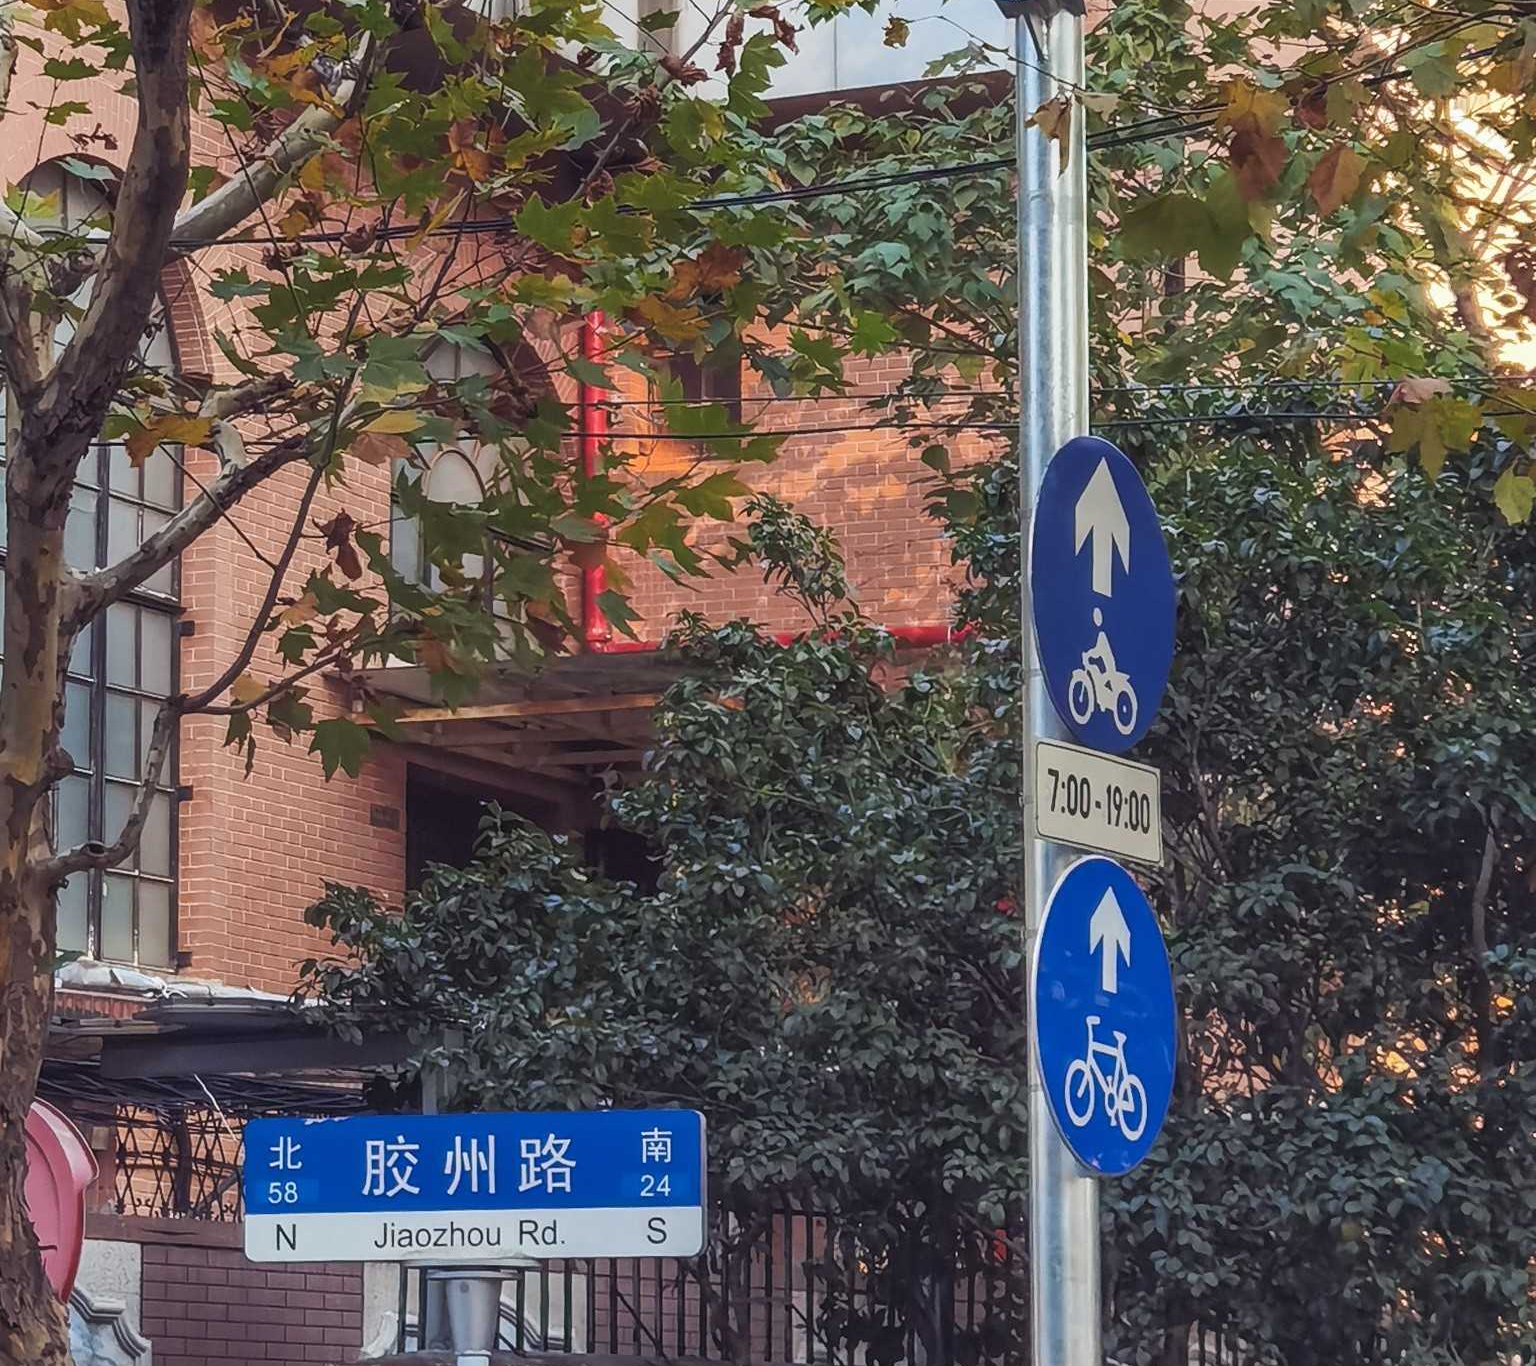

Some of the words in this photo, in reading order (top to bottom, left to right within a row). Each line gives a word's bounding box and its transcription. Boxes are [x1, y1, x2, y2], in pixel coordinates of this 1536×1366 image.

[268, 1136, 303, 1171] 北
[640, 1126, 673, 1164] 南
[361, 1132, 577, 1197] 胶州路
[267, 1181, 299, 1205] 58
[639, 1174, 672, 1198] 24
[275, 1223, 297, 1251] N
[373, 1219, 502, 1249] Jiaozhou
[518, 1218, 566, 1247] Rd.
[646, 1216, 668, 1245] S
